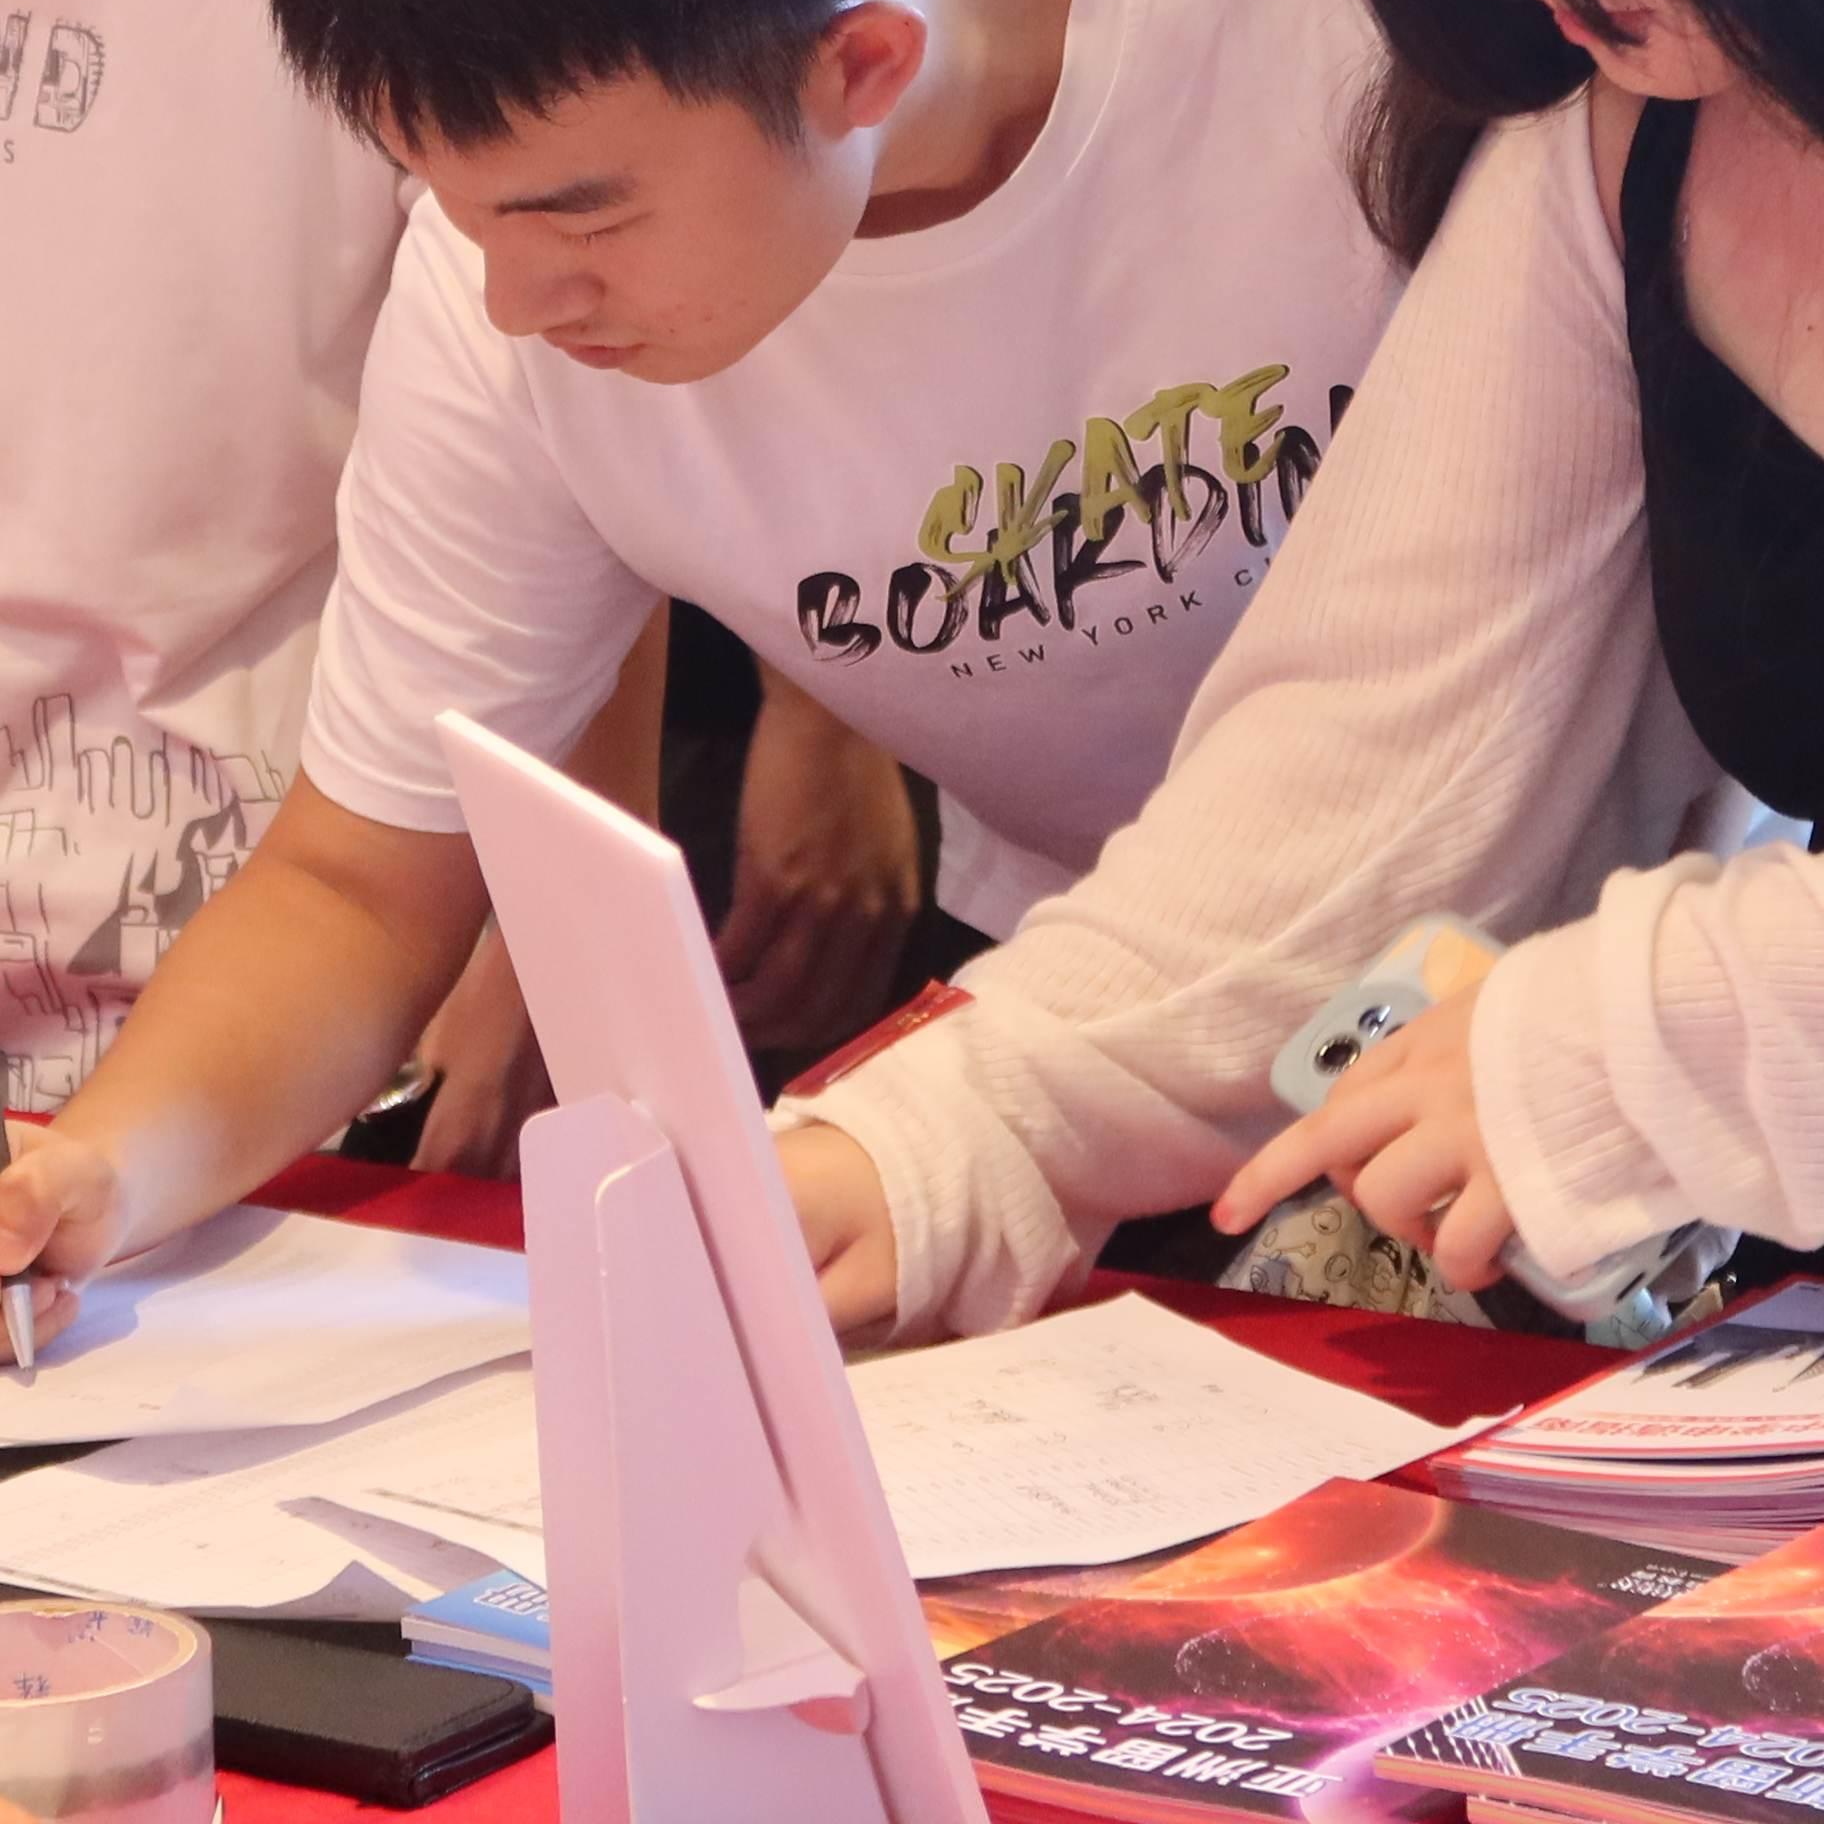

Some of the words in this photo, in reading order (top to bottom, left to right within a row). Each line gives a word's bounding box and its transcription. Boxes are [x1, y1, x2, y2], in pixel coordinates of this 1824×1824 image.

[918, 363, 1290, 601] SKATE
[950, 645, 1046, 679] NEW
[1082, 591, 1202, 647] YORK
[1234, 556, 1273, 587] C
[946, 1662, 1294, 1751] 2024-2025
